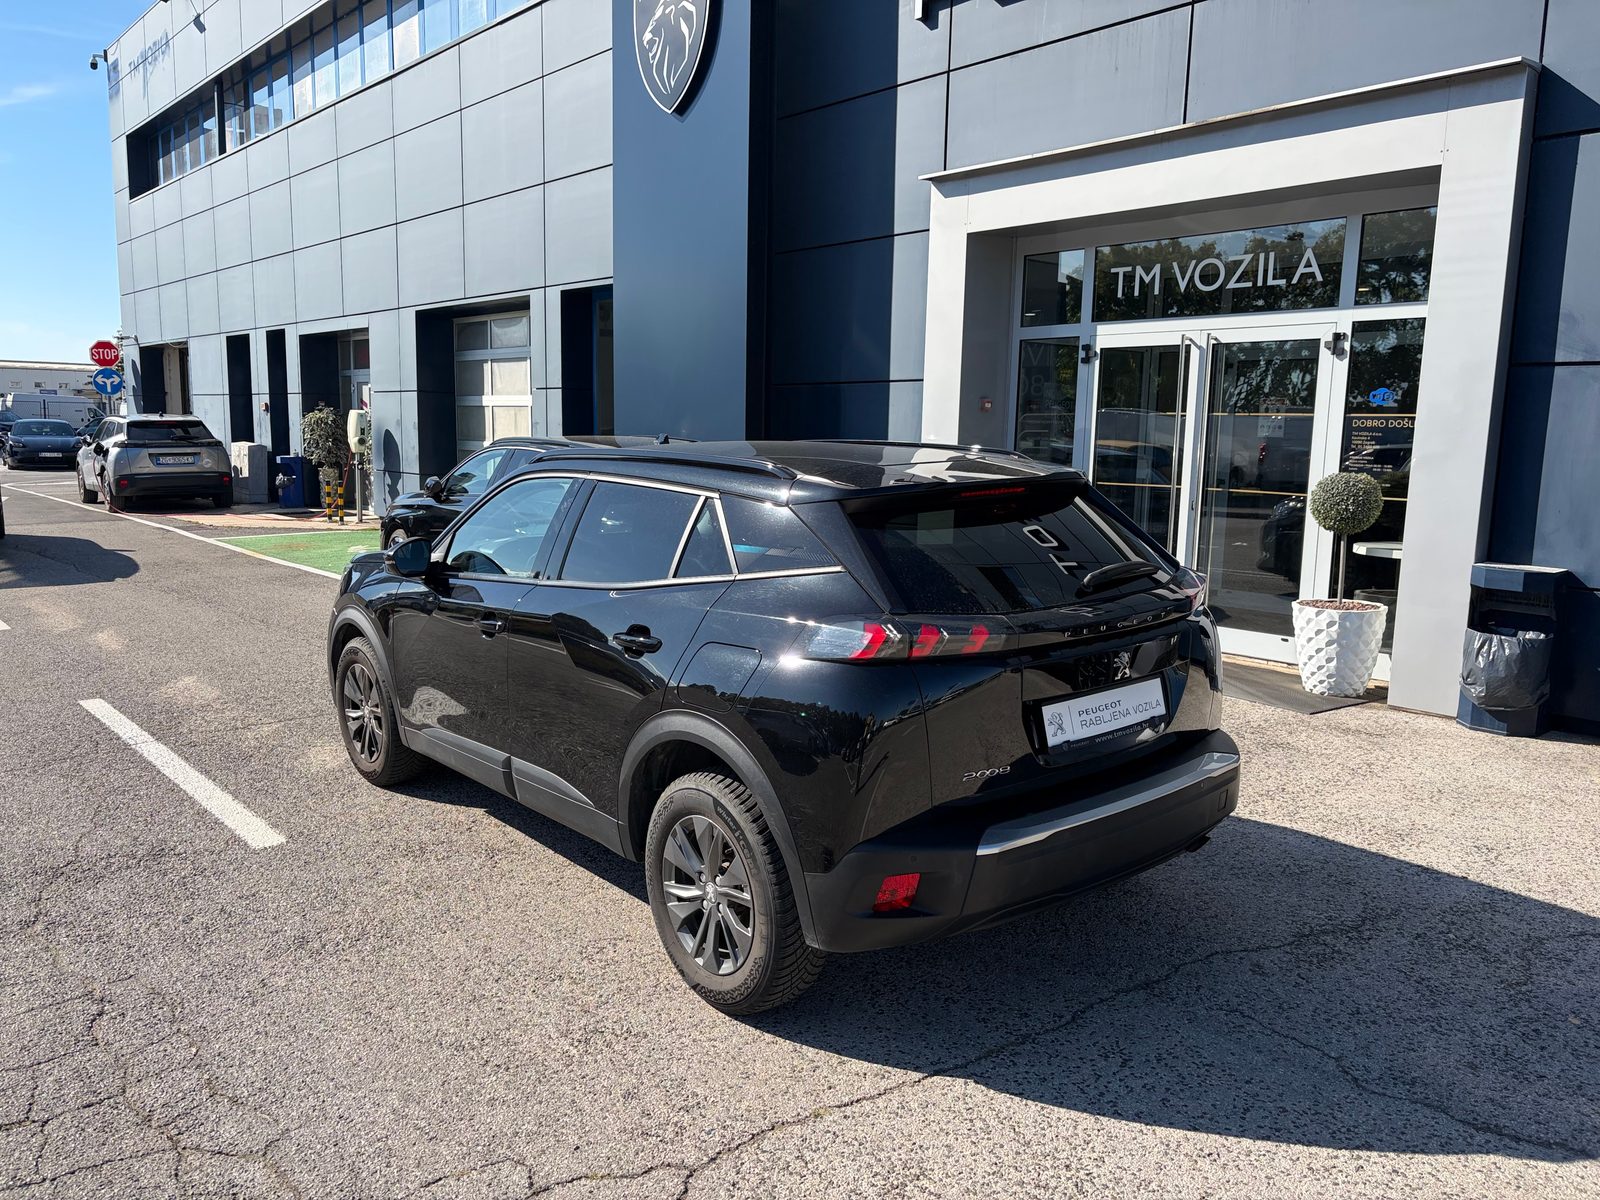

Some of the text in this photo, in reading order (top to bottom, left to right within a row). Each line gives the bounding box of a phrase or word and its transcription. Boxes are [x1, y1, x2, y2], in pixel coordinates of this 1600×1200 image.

[1110, 247, 1323, 298] TM VOZILA
[92, 348, 118, 360] STOP
[1352, 417, 1415, 428] DOBRO DOŠL
[1064, 611, 1166, 638] PEUGEOT
[1078, 699, 1122, 717] PEUGEOT
[1080, 698, 1162, 730] RABLJENA VOZILA
[1094, 722, 1149, 744] www.tmvozila.hr
[962, 765, 1011, 782] 2008
